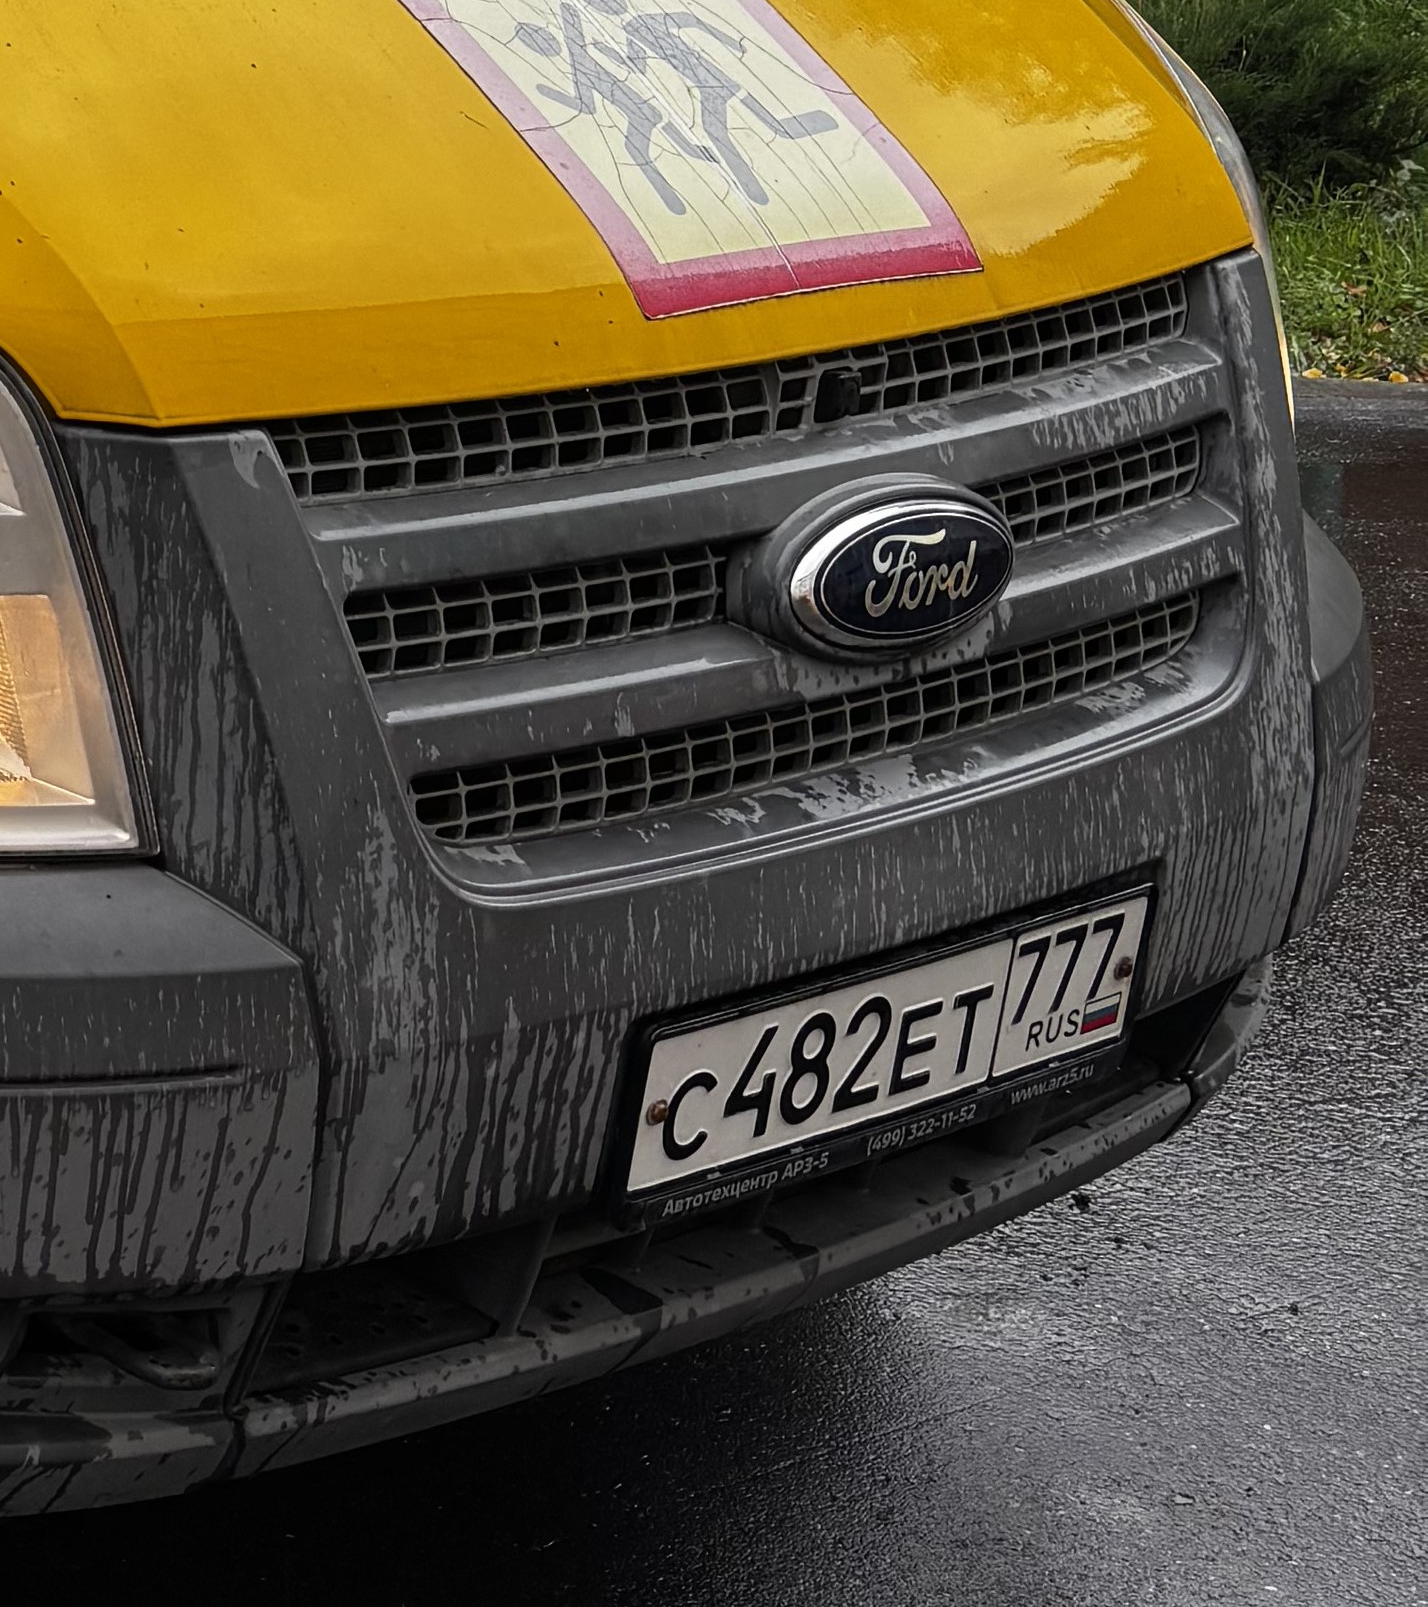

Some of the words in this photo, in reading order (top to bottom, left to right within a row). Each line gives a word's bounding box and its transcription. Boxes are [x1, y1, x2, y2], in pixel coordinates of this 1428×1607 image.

[865, 528, 979, 618] Ford
[1011, 912, 1126, 1026] 777
[1025, 1008, 1081, 1052] RUS
[662, 1170, 779, 1218] Автотехцентр
